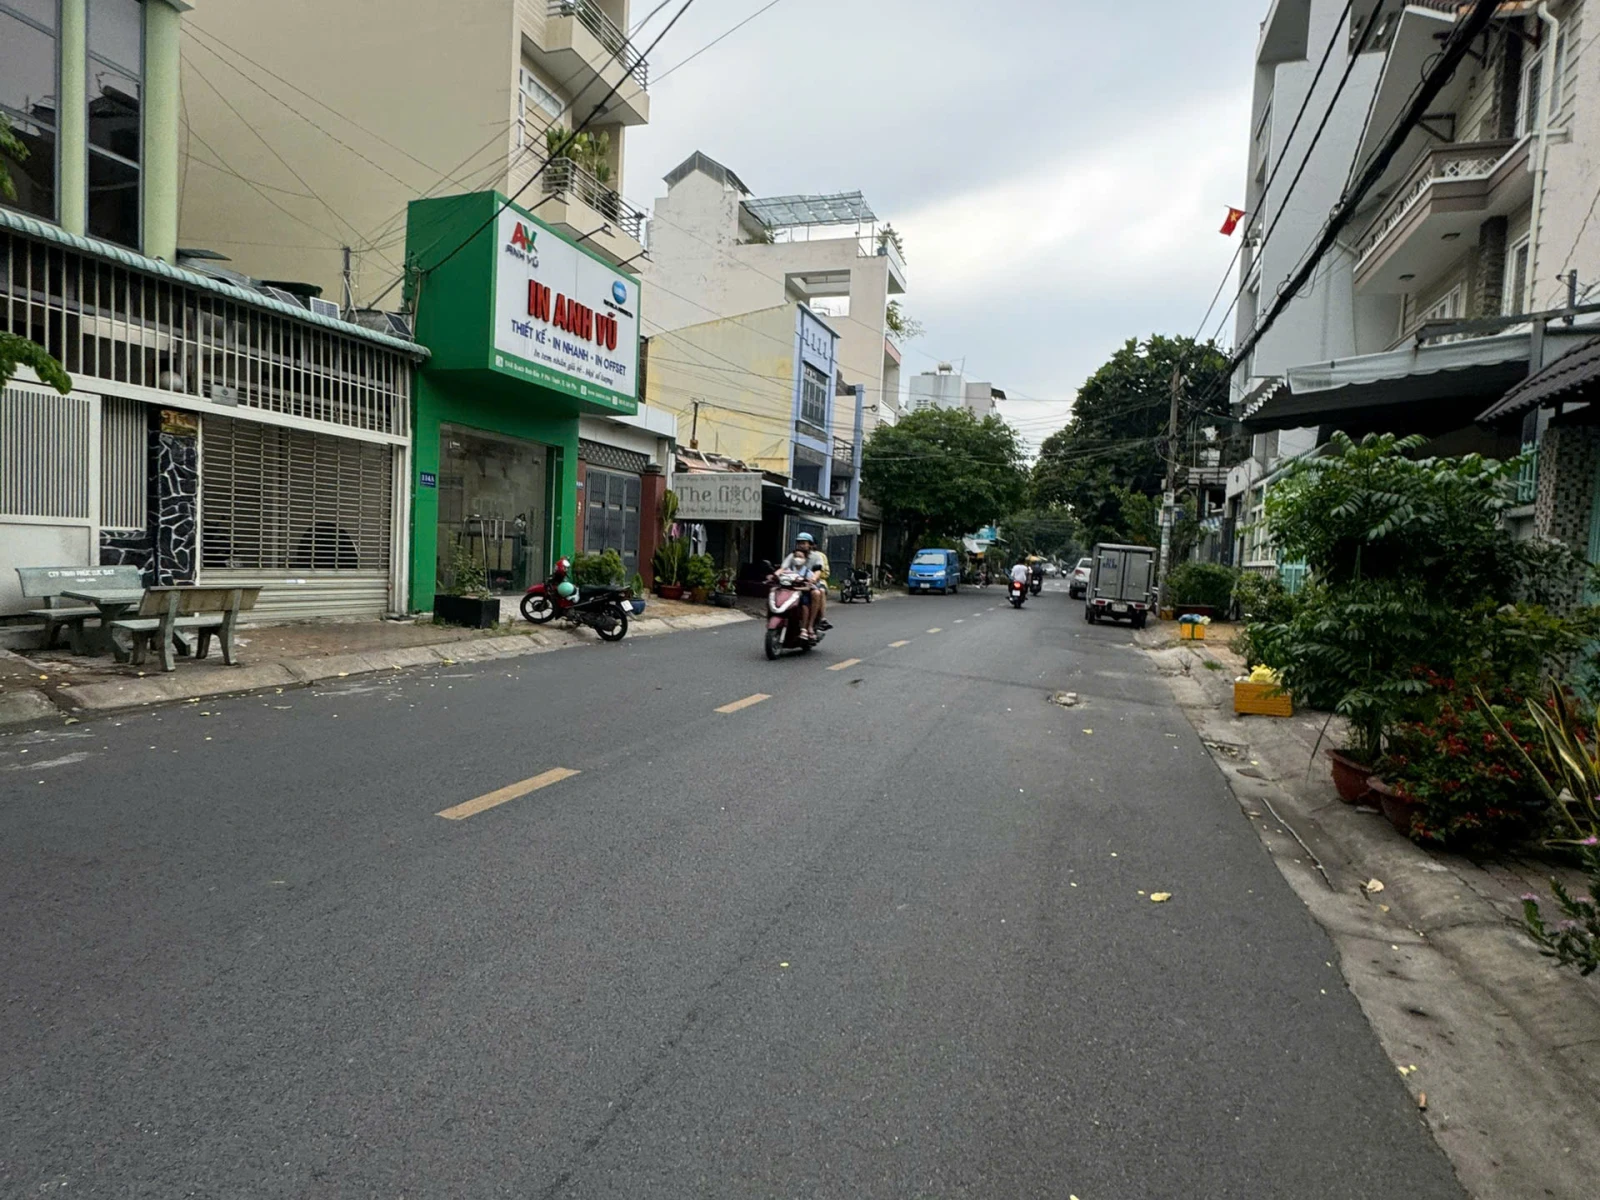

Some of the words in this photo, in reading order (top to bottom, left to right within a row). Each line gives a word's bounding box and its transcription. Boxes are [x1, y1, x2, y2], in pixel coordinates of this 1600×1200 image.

[505, 244, 525, 260] ANH
[511, 221, 538, 253] AV
[528, 279, 551, 323] IN
[553, 293, 594, 342] ANH
[595, 311, 618, 351] VŨ
[511, 319, 533, 339] THIẾT
[536, 328, 547, 345] KẾ
[553, 336, 561, 351] IN
[563, 341, 589, 361] NHANH
[595, 354, 603, 367] IN
[604, 358, 627, 376] OFFSET
[676, 486, 712, 502] The
